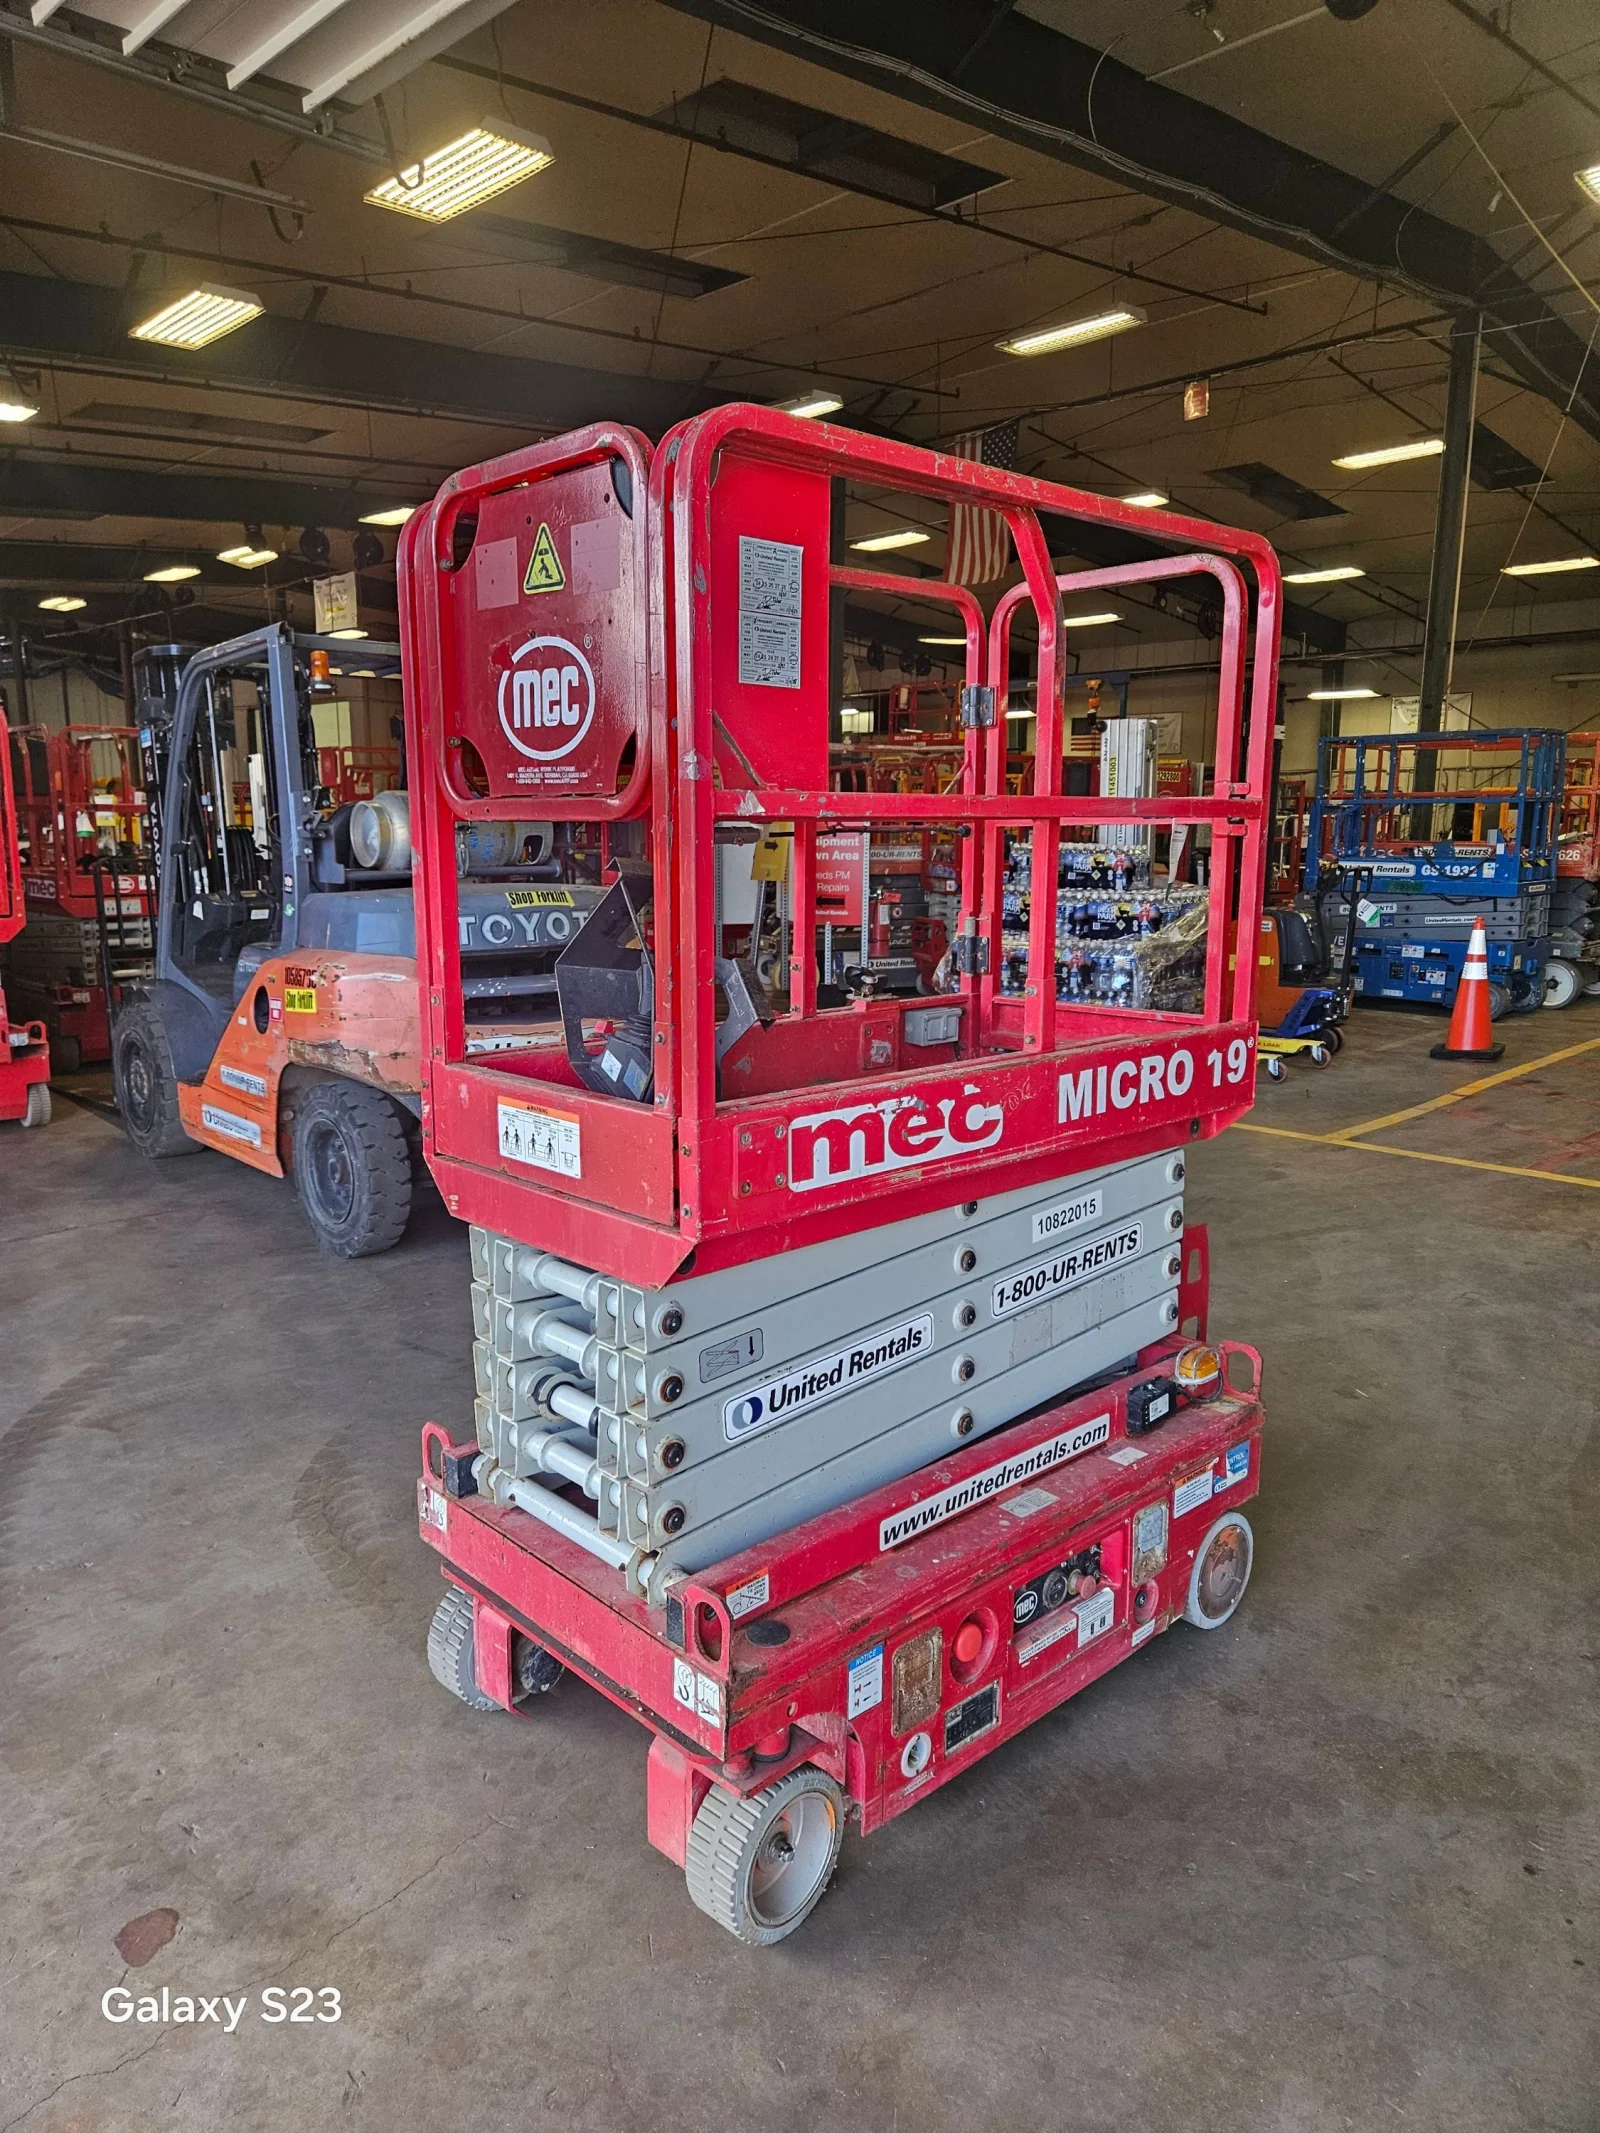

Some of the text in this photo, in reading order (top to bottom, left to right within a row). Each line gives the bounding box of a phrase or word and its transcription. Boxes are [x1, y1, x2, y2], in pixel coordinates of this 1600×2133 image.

[149, 802, 161, 878] TOYOTA
[832, 851, 859, 860] Area
[1556, 849, 1581, 860] 626
[835, 871, 850, 879] PM
[1376, 865, 1410, 873] Rentals
[817, 883, 850, 893] Repairs
[509, 889, 569, 905] Shop Forklift
[1098, 912, 1116, 920] PARK
[876, 959, 899, 967] United
[286, 991, 313, 1009] Shop Forklift
[1058, 1049, 1194, 1124] MICRO
[530, 1106, 548, 1114] WARNING
[791, 1096, 1001, 1184] mec
[1038, 1198, 1096, 1234] 10822015
[997, 1230, 1138, 1308] 1-800-UR-RENTS
[769, 1327, 923, 1413] United Rentals
[884, 1423, 1107, 1545] www.unitedrentals.com
[856, 1649, 877, 1666] NOTICE
